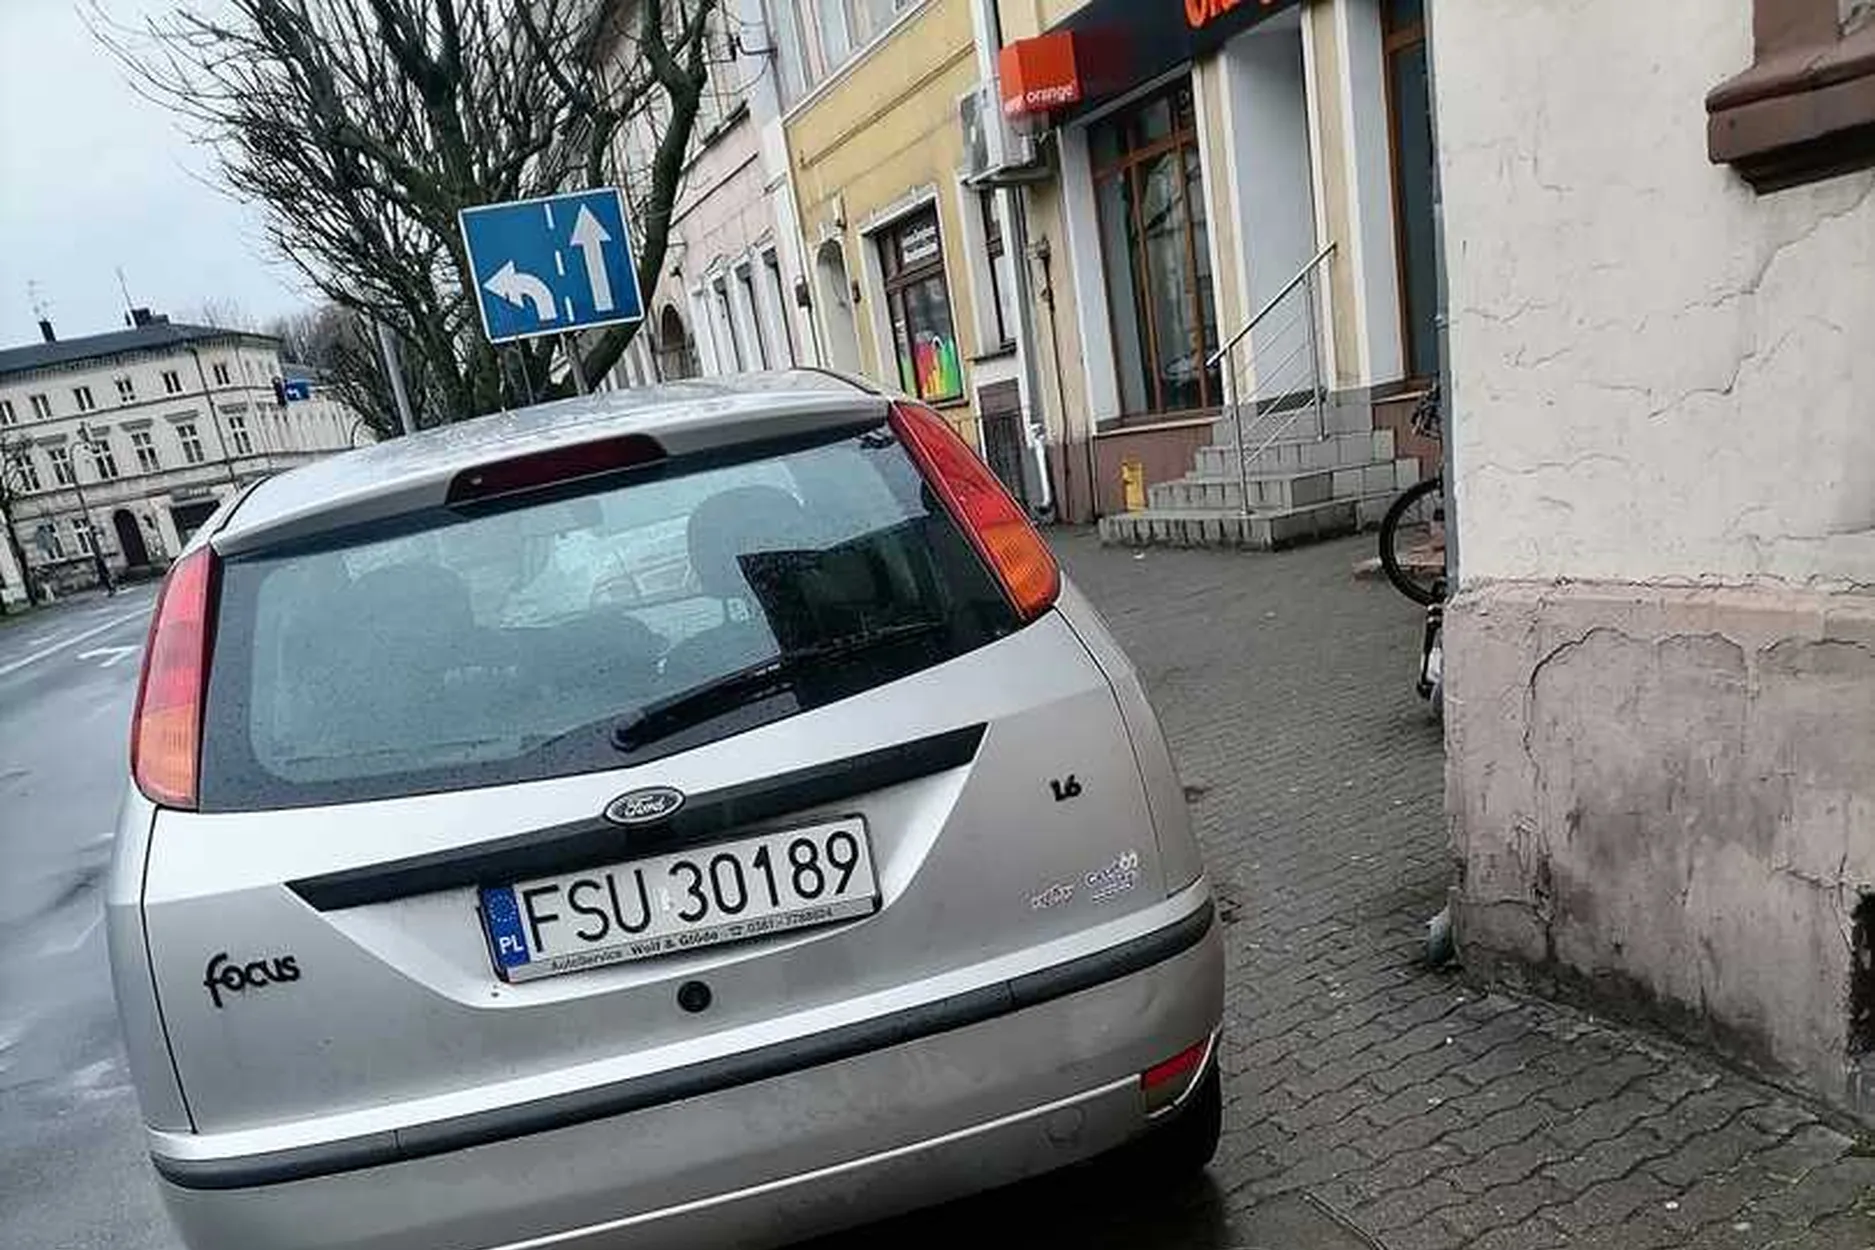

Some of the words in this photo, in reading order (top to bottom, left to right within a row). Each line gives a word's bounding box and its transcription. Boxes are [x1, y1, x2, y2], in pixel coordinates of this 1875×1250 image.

[1026, 85, 1074, 104] orange
[622, 795, 666, 817] Ford
[522, 868, 653, 953] FSU
[668, 830, 860, 923] 30189
[499, 936, 525, 955] PL
